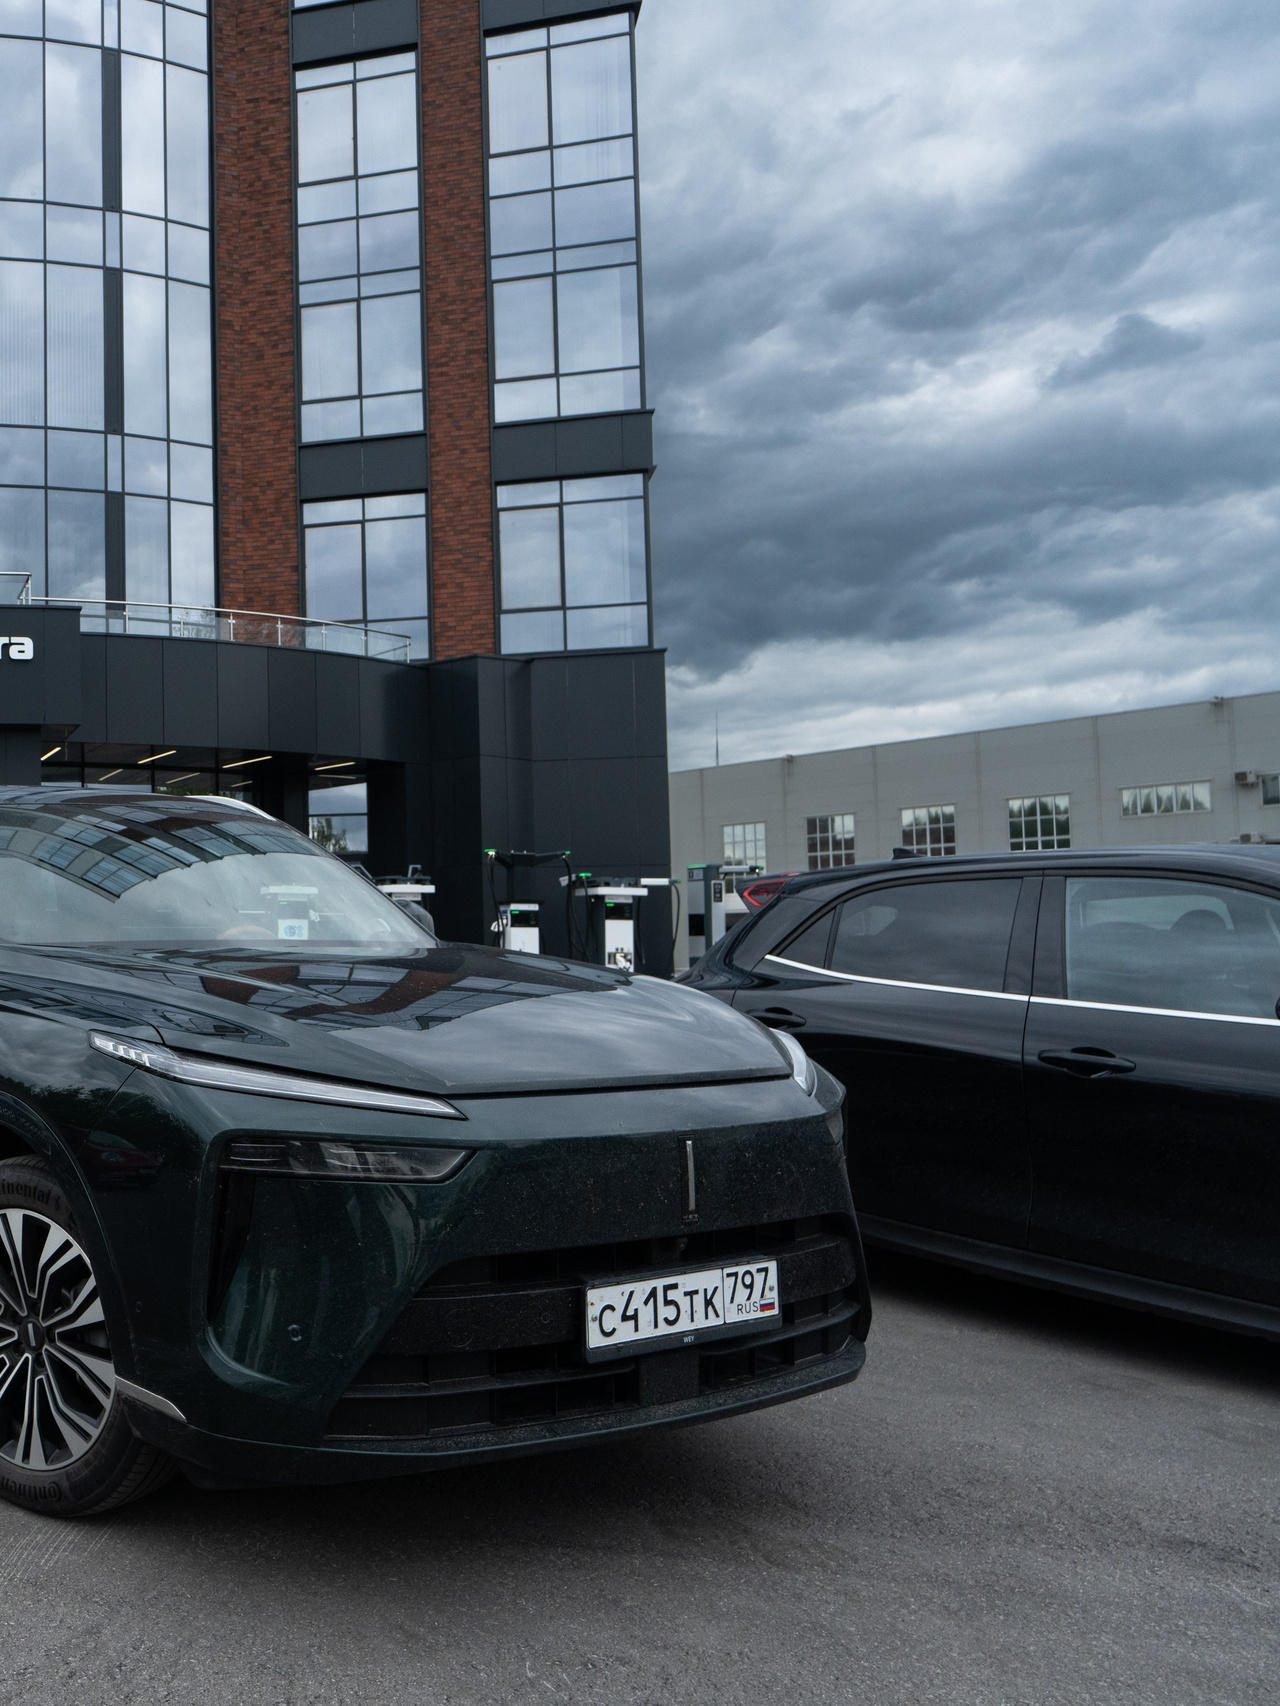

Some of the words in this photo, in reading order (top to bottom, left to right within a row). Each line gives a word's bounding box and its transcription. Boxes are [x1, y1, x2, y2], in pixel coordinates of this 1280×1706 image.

[726, 1266, 769, 1304] 797
[737, 1301, 759, 1315] RUS
[683, 1335, 695, 1343] WEY
